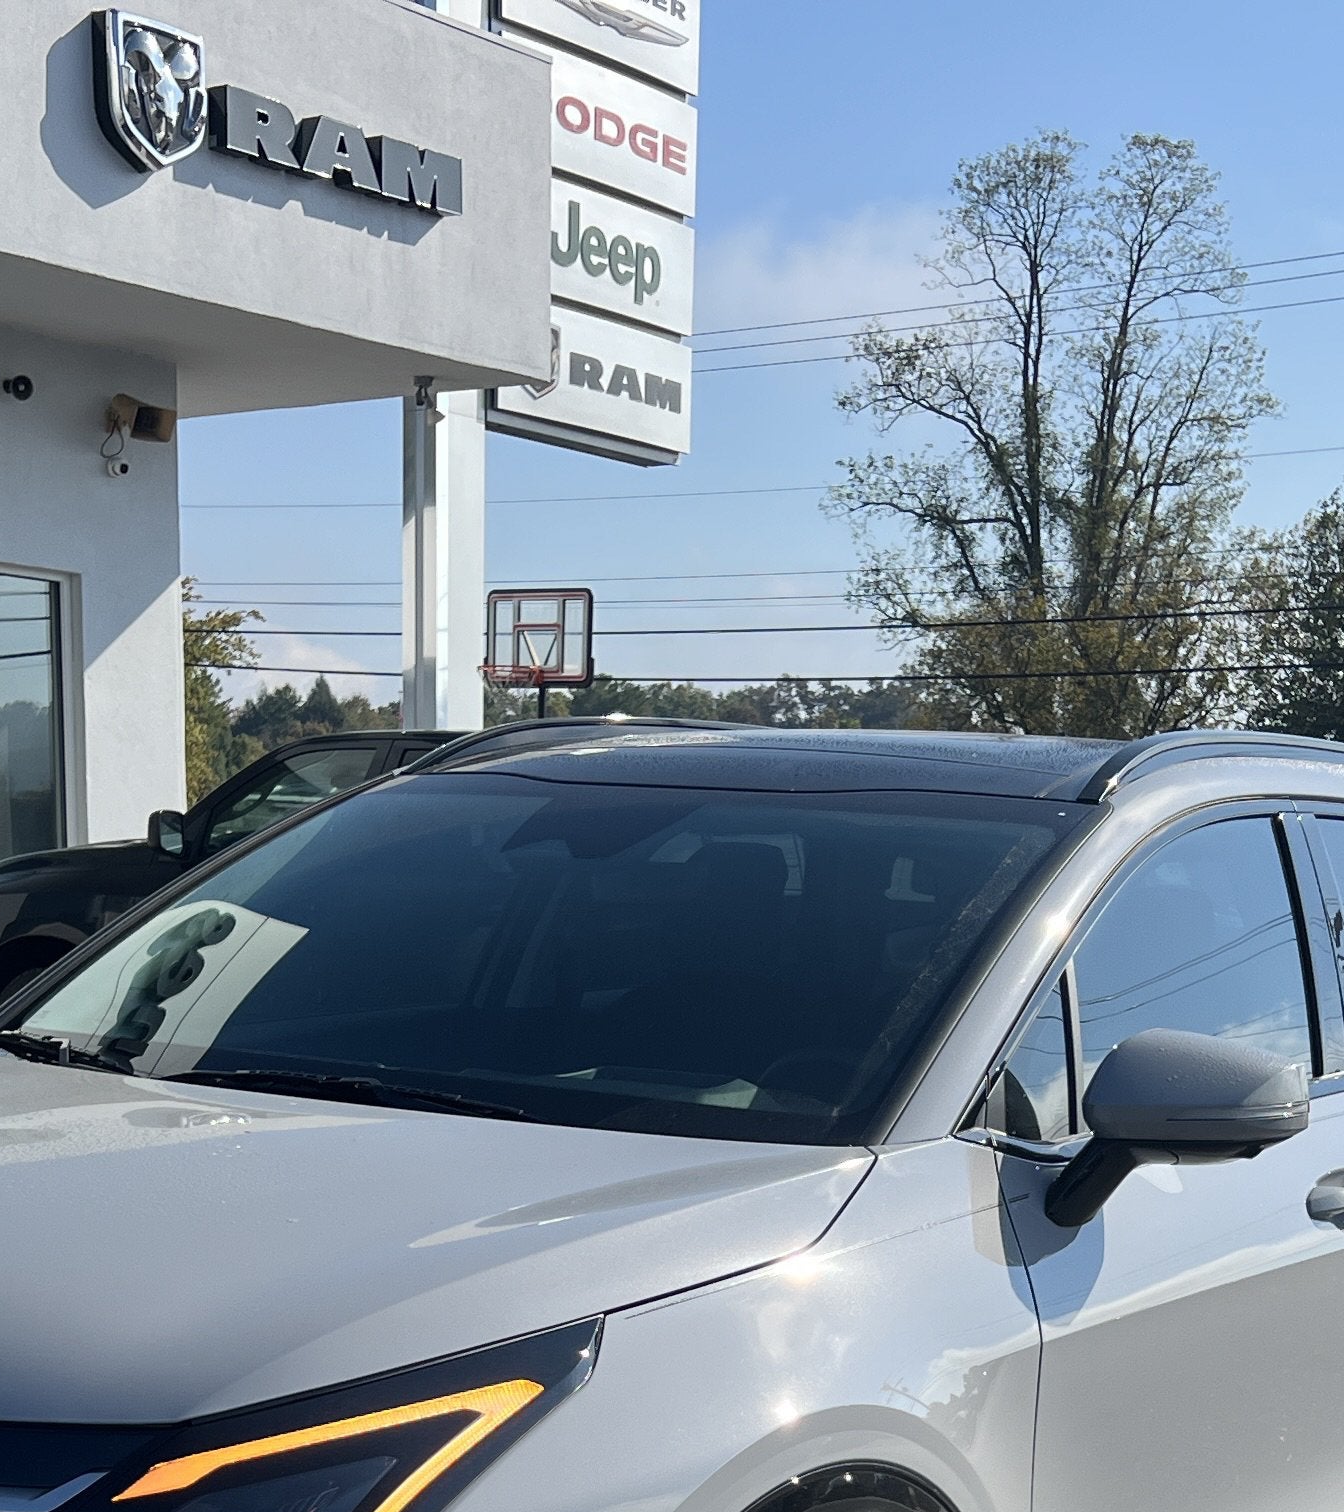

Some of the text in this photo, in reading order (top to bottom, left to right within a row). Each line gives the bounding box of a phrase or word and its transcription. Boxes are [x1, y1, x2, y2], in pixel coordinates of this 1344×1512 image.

[211, 84, 462, 216] RAM
[556, 95, 688, 176] ODGE
[551, 200, 662, 306] Jeep
[569, 351, 682, 415] RAM
